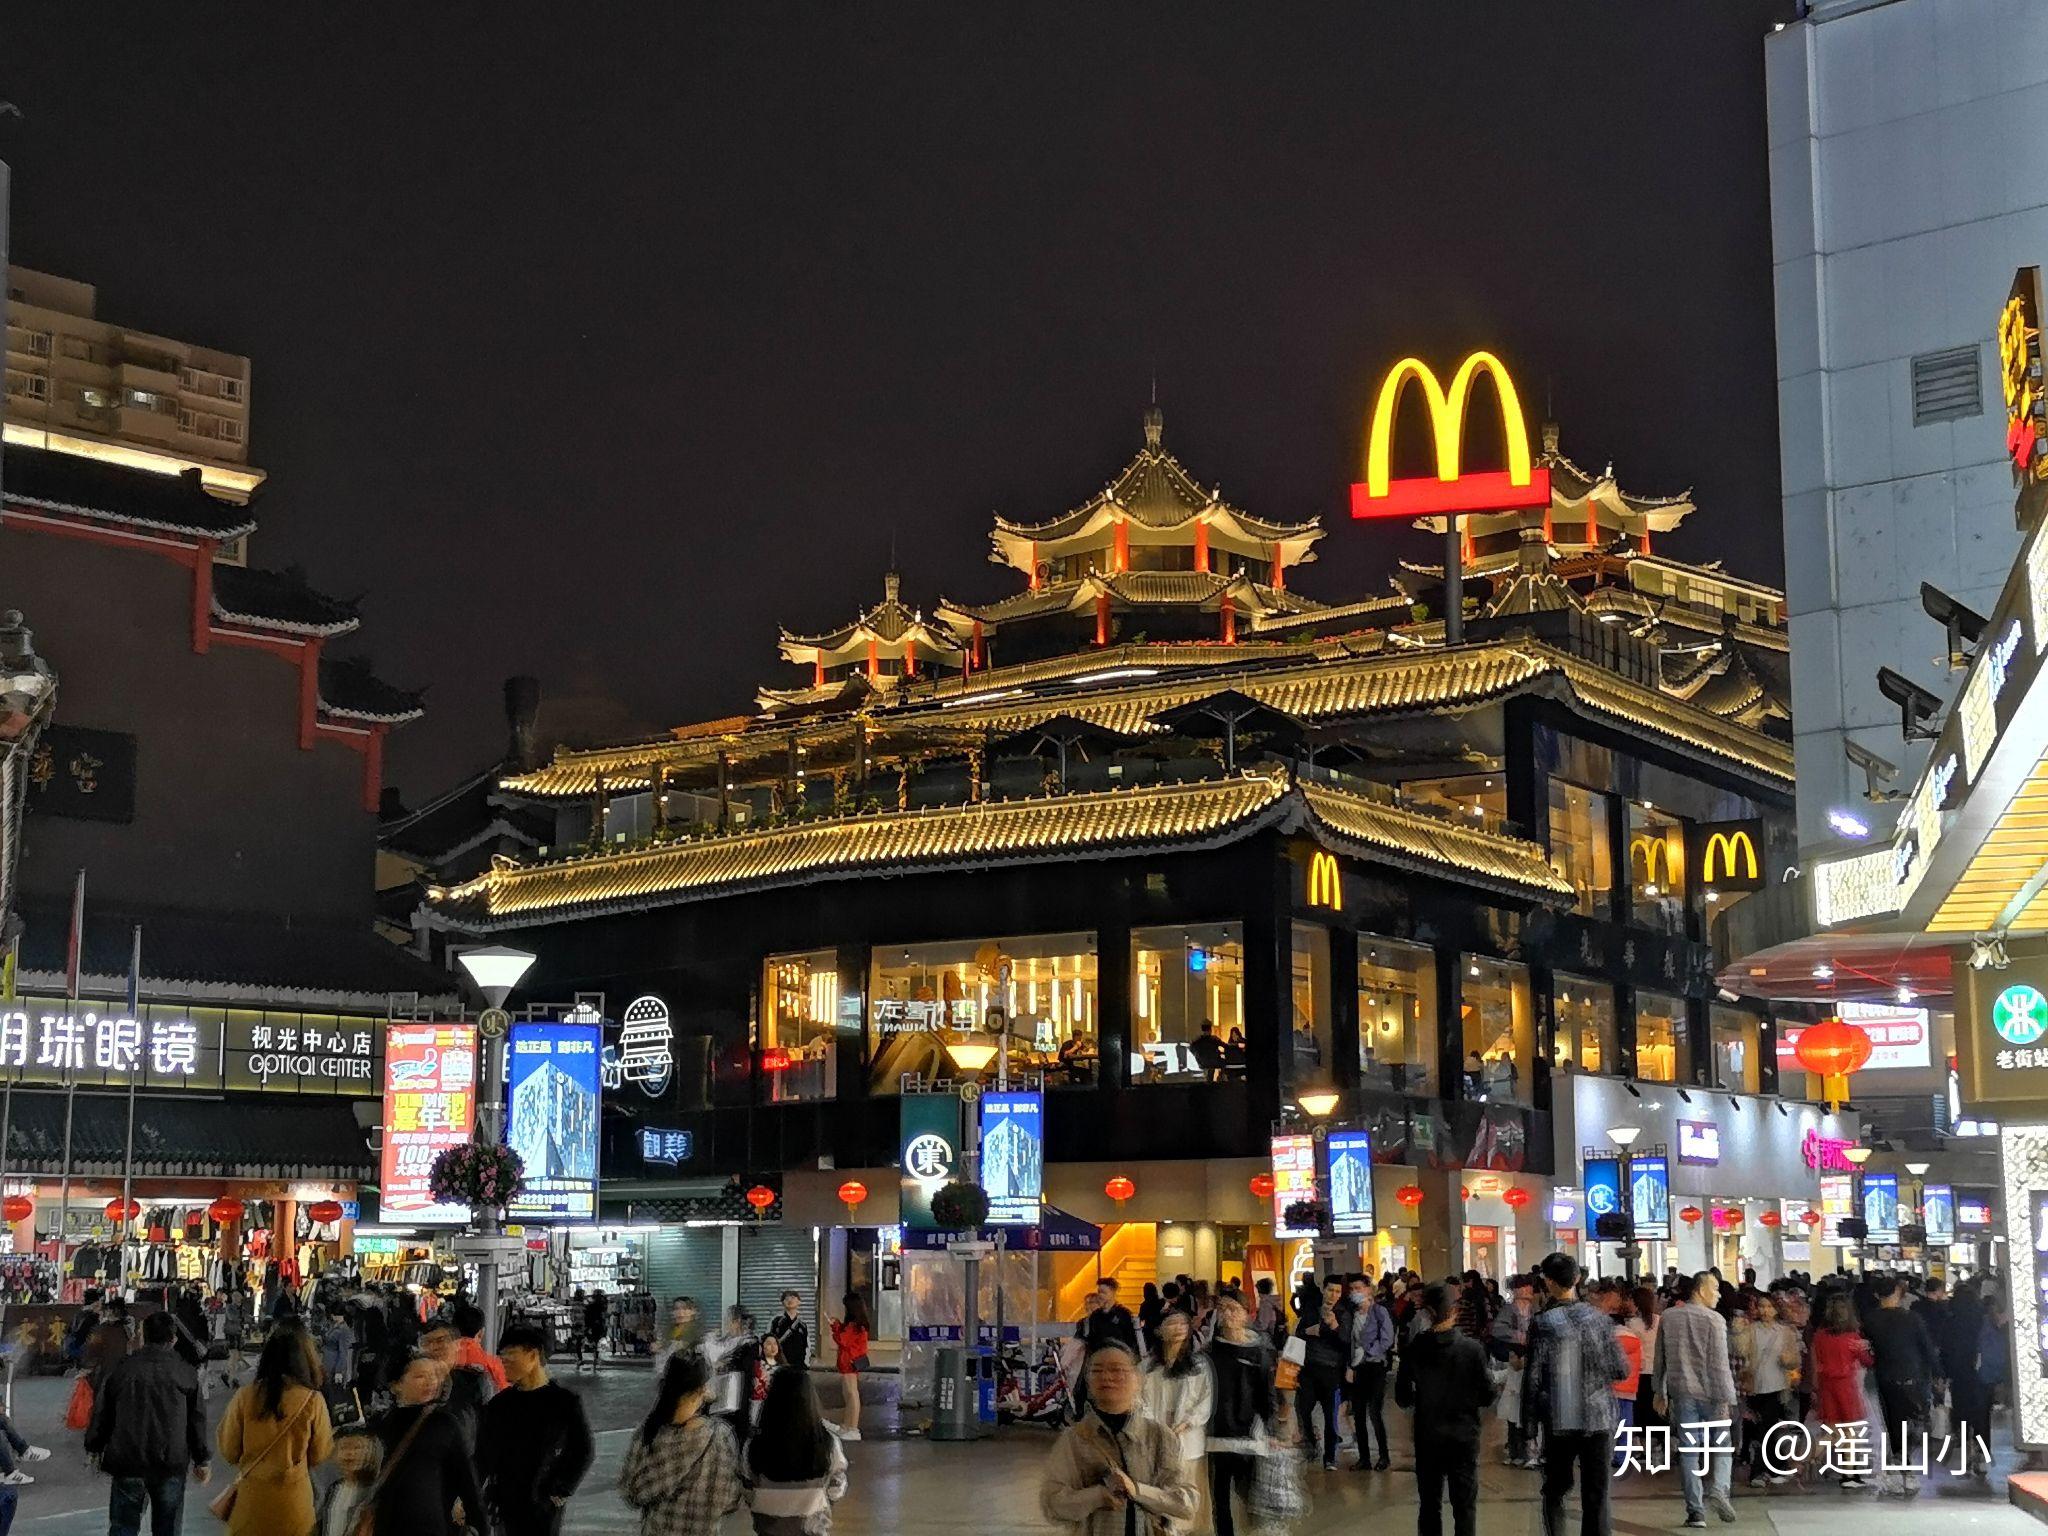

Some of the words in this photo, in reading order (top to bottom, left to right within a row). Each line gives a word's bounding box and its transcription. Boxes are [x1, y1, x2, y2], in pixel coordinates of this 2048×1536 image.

[252, 1025, 371, 1055] 视光中心店
[1995, 1047, 2048, 1069] 老街站
